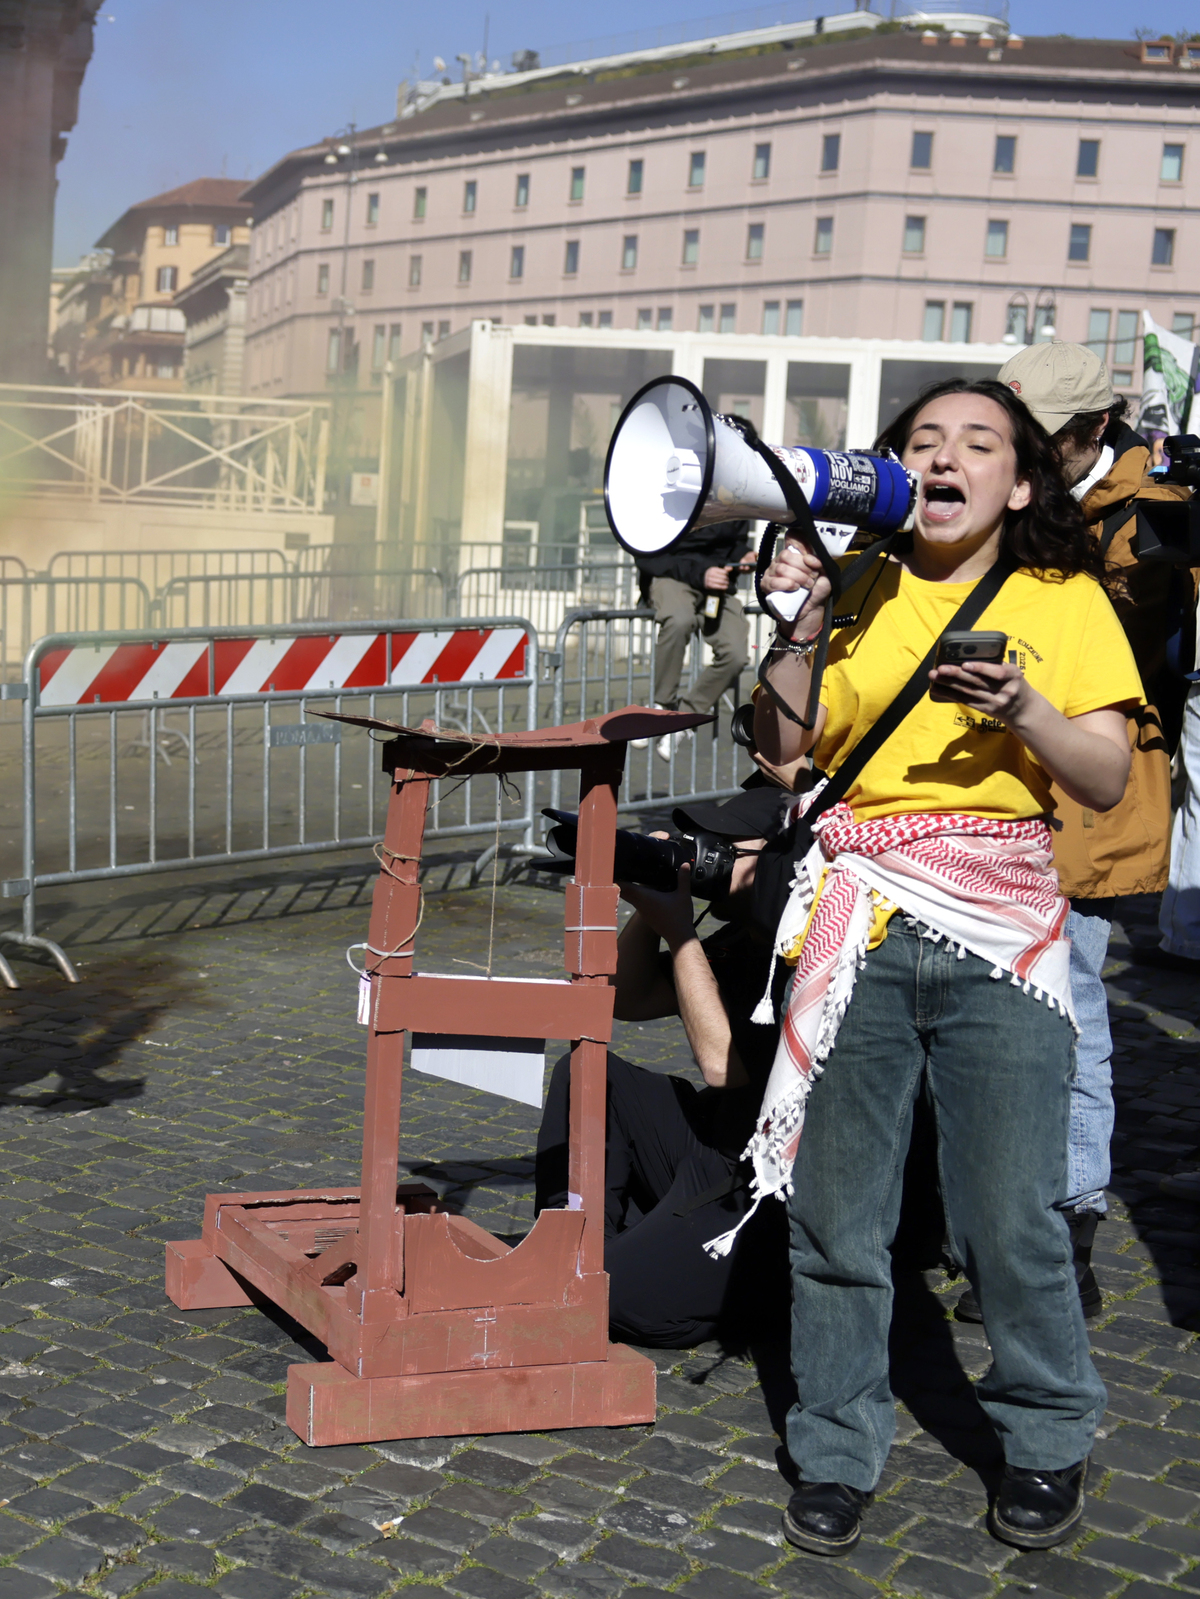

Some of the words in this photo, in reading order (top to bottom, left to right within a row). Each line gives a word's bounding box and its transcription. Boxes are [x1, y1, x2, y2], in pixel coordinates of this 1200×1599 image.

[822, 450, 850, 467] 15
[831, 463, 853, 481] NOV
[830, 478, 870, 493] VOGLIAMO
[1017, 638, 1044, 664] EDIZIONE
